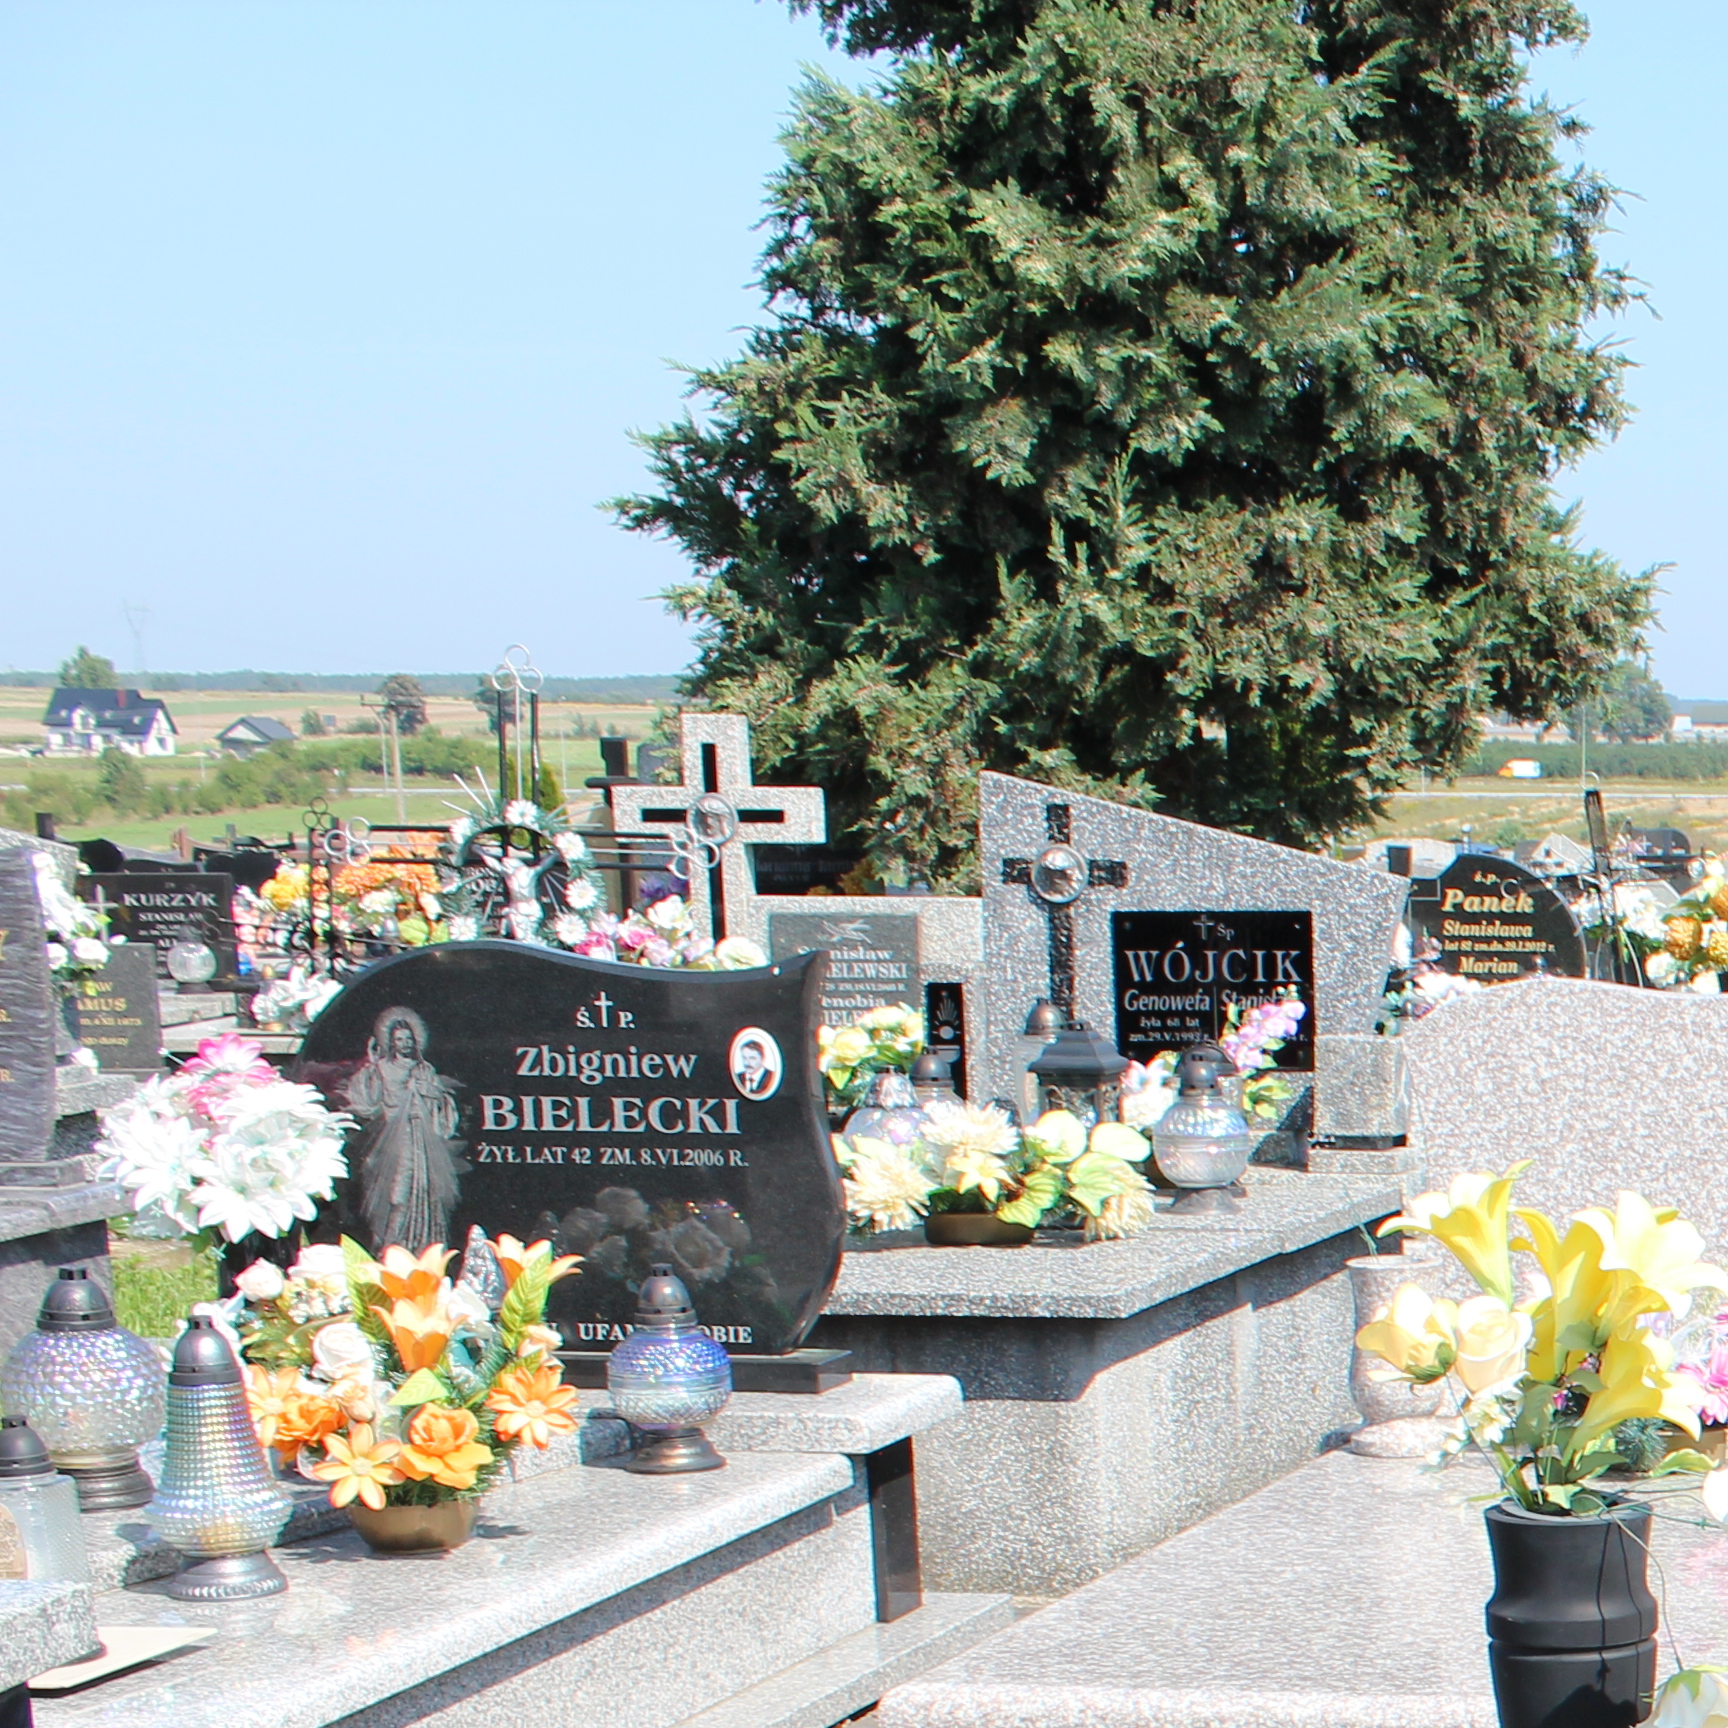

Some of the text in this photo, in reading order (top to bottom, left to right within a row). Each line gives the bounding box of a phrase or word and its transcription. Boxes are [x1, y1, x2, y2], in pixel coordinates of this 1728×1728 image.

[122, 892, 219, 907] KURZYK
[1441, 888, 1534, 913] Panek
[1442, 919, 1533, 937] Stanisława
[826, 962, 909, 979] ELEWSKI
[1124, 940, 1303, 983] WÓJCIK
[1459, 956, 1519, 974] Marian
[820, 994, 887, 1008] enobia
[1124, 988, 1210, 1012] Genowefa
[576, 1006, 635, 1029] Ś. P.
[1186, 1016, 1199, 1027] lat
[515, 1044, 698, 1086] Zbigniew
[479, 1094, 742, 1134] BIELECKI
[477, 1142, 749, 1167] ŻYŁ LAT 42 ZM. 8.VI.2006 R.
